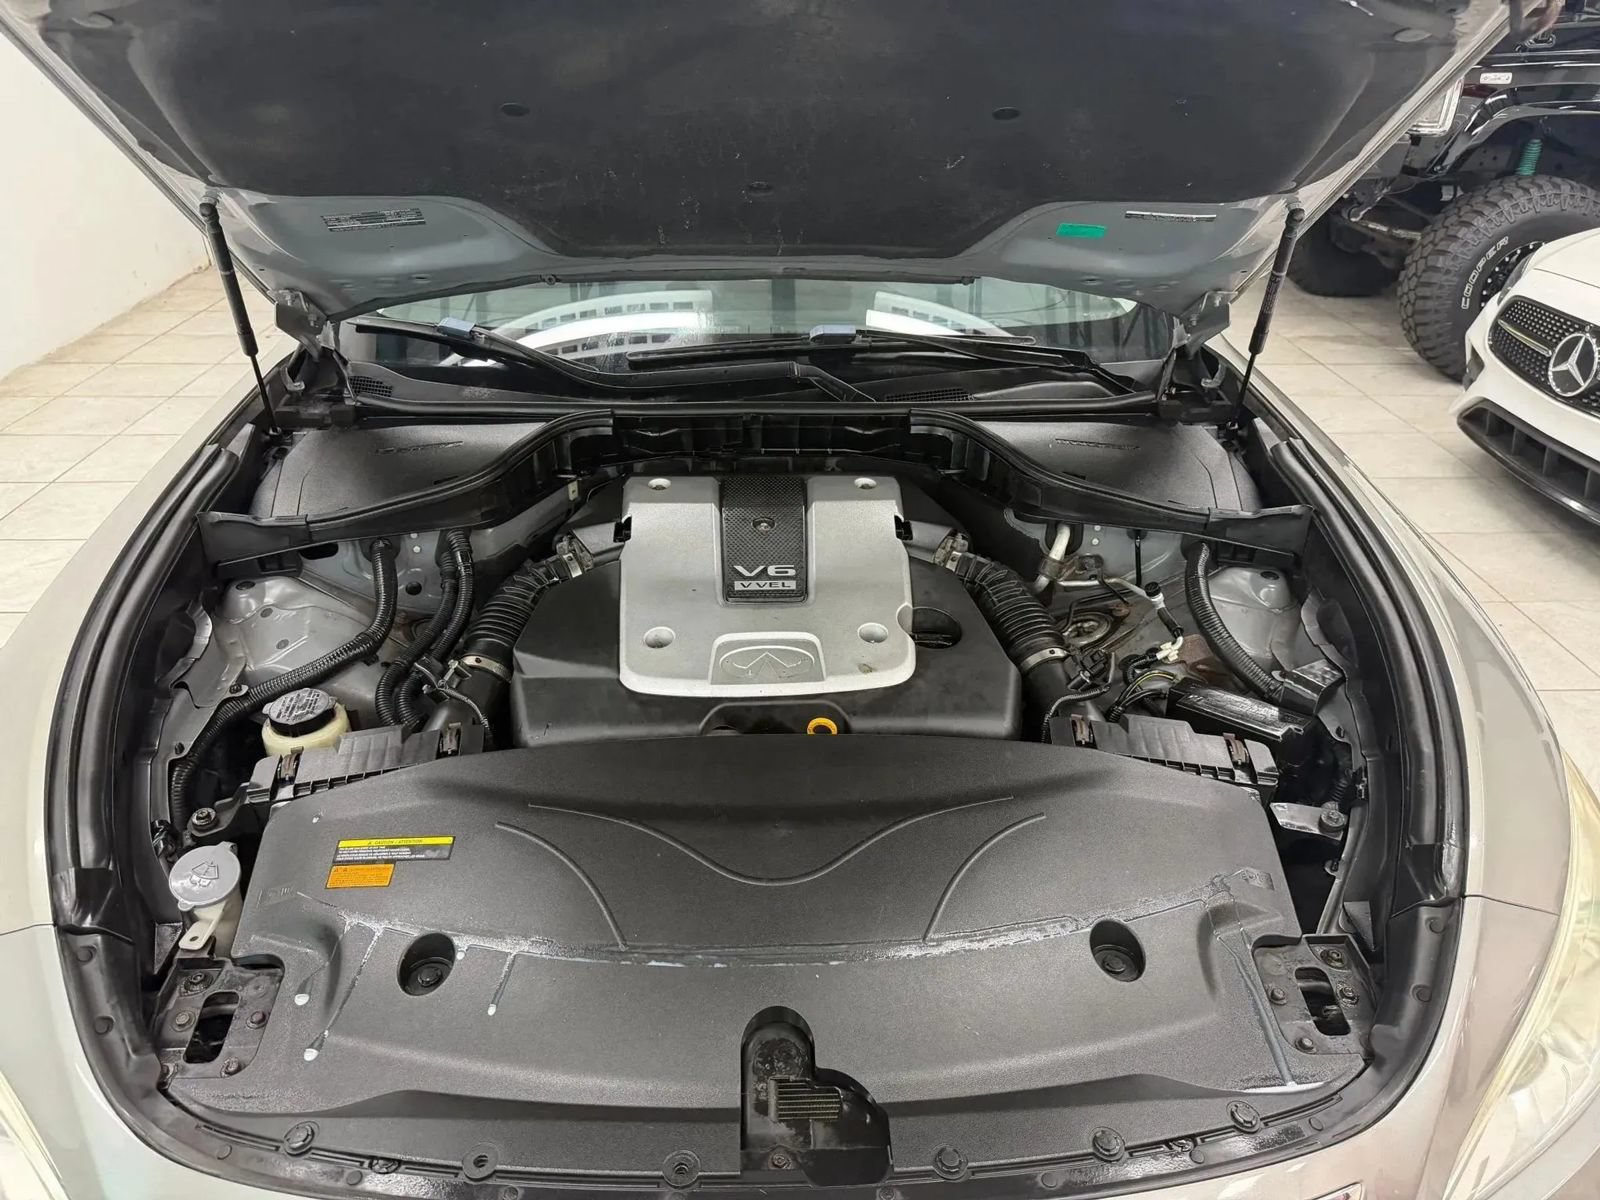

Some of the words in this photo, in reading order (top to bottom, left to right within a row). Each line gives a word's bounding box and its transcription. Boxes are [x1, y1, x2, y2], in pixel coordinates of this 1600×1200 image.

[1461, 236, 1509, 309] COOPER
[733, 564, 797, 577] V6
[740, 581, 792, 589] VVEL
